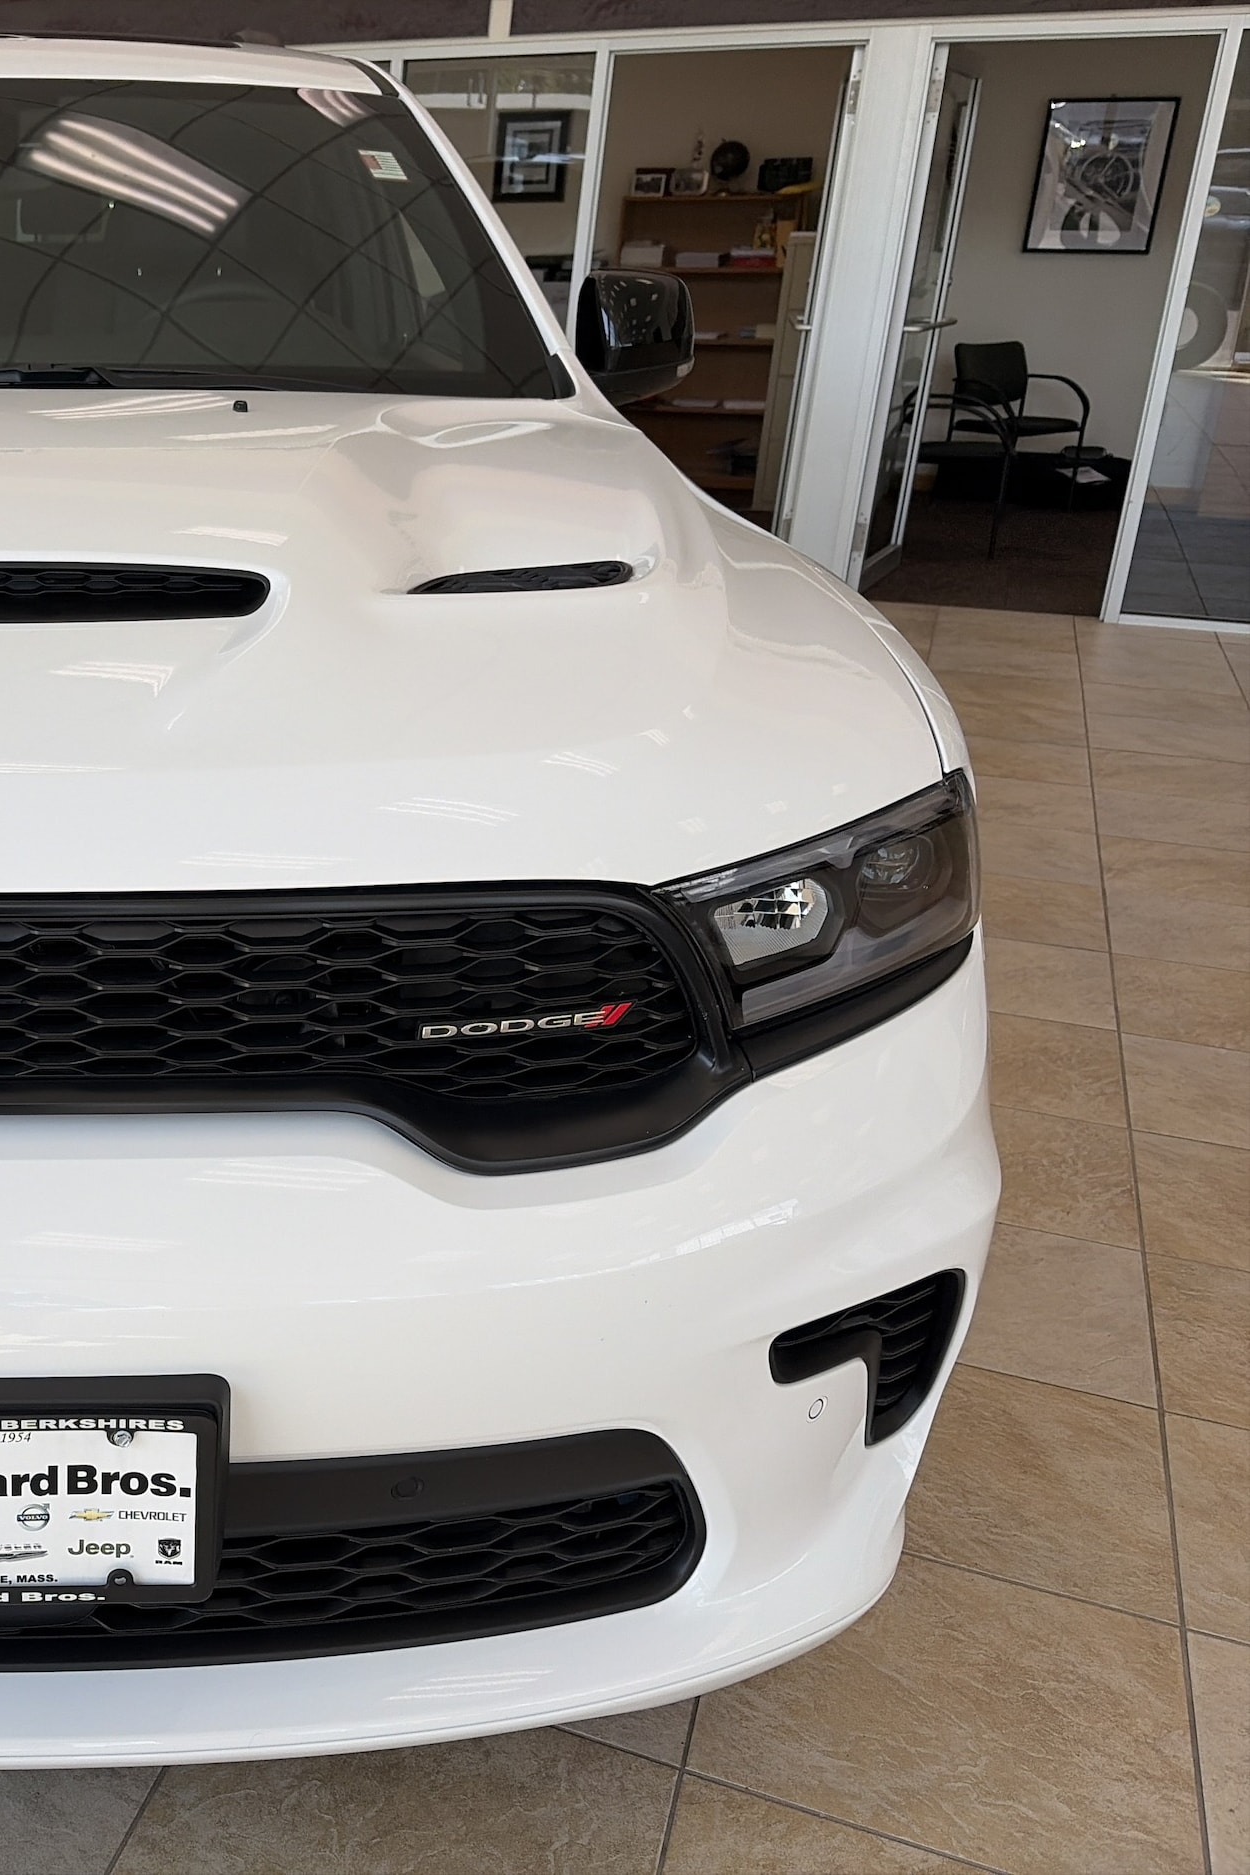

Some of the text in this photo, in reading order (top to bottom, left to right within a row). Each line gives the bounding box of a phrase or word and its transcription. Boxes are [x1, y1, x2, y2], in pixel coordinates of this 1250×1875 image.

[421, 1010, 606, 1039] DODGE
[0, 1418, 185, 1431] BERKSHIRES
[0, 1432, 31, 1443] 1954
[66, 1464, 192, 1498] Bros.
[18, 1513, 49, 1522] VOLVO
[118, 1510, 188, 1522] CHEVROLET
[67, 1539, 131, 1558] Jeep
[16, 1574, 59, 1584] MASS.
[21, 1592, 106, 1602] Bros.
